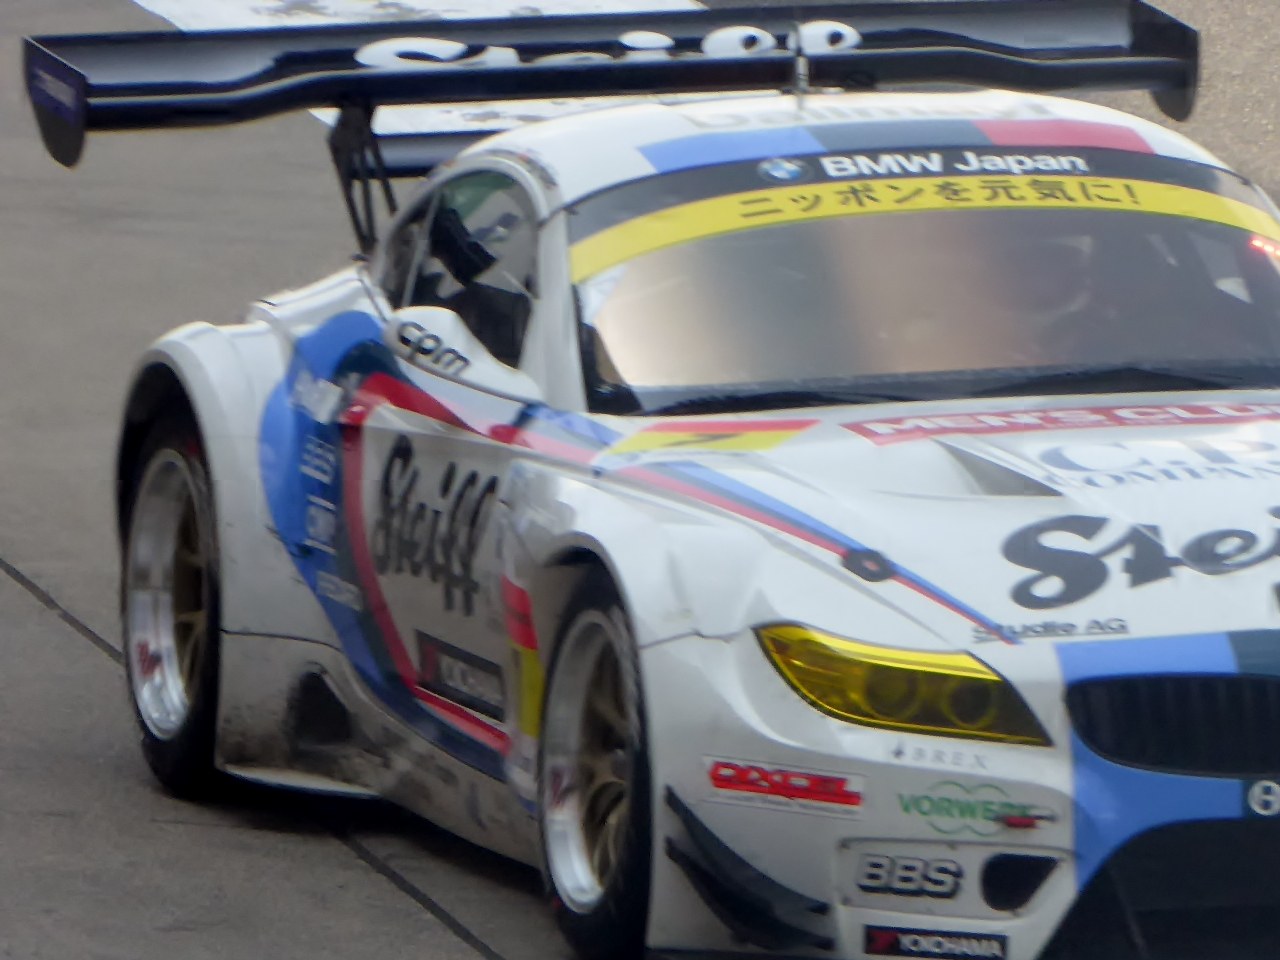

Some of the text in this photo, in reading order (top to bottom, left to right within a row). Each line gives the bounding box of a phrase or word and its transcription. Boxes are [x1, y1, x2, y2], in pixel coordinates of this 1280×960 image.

[821, 151, 1090, 178] BMW Japan
[739, 177, 1140, 219] ニッポンを元気に!
[396, 319, 471, 377] cpm
[857, 853, 964, 898] BBS
[897, 931, 1003, 958] YOKOHAMA
